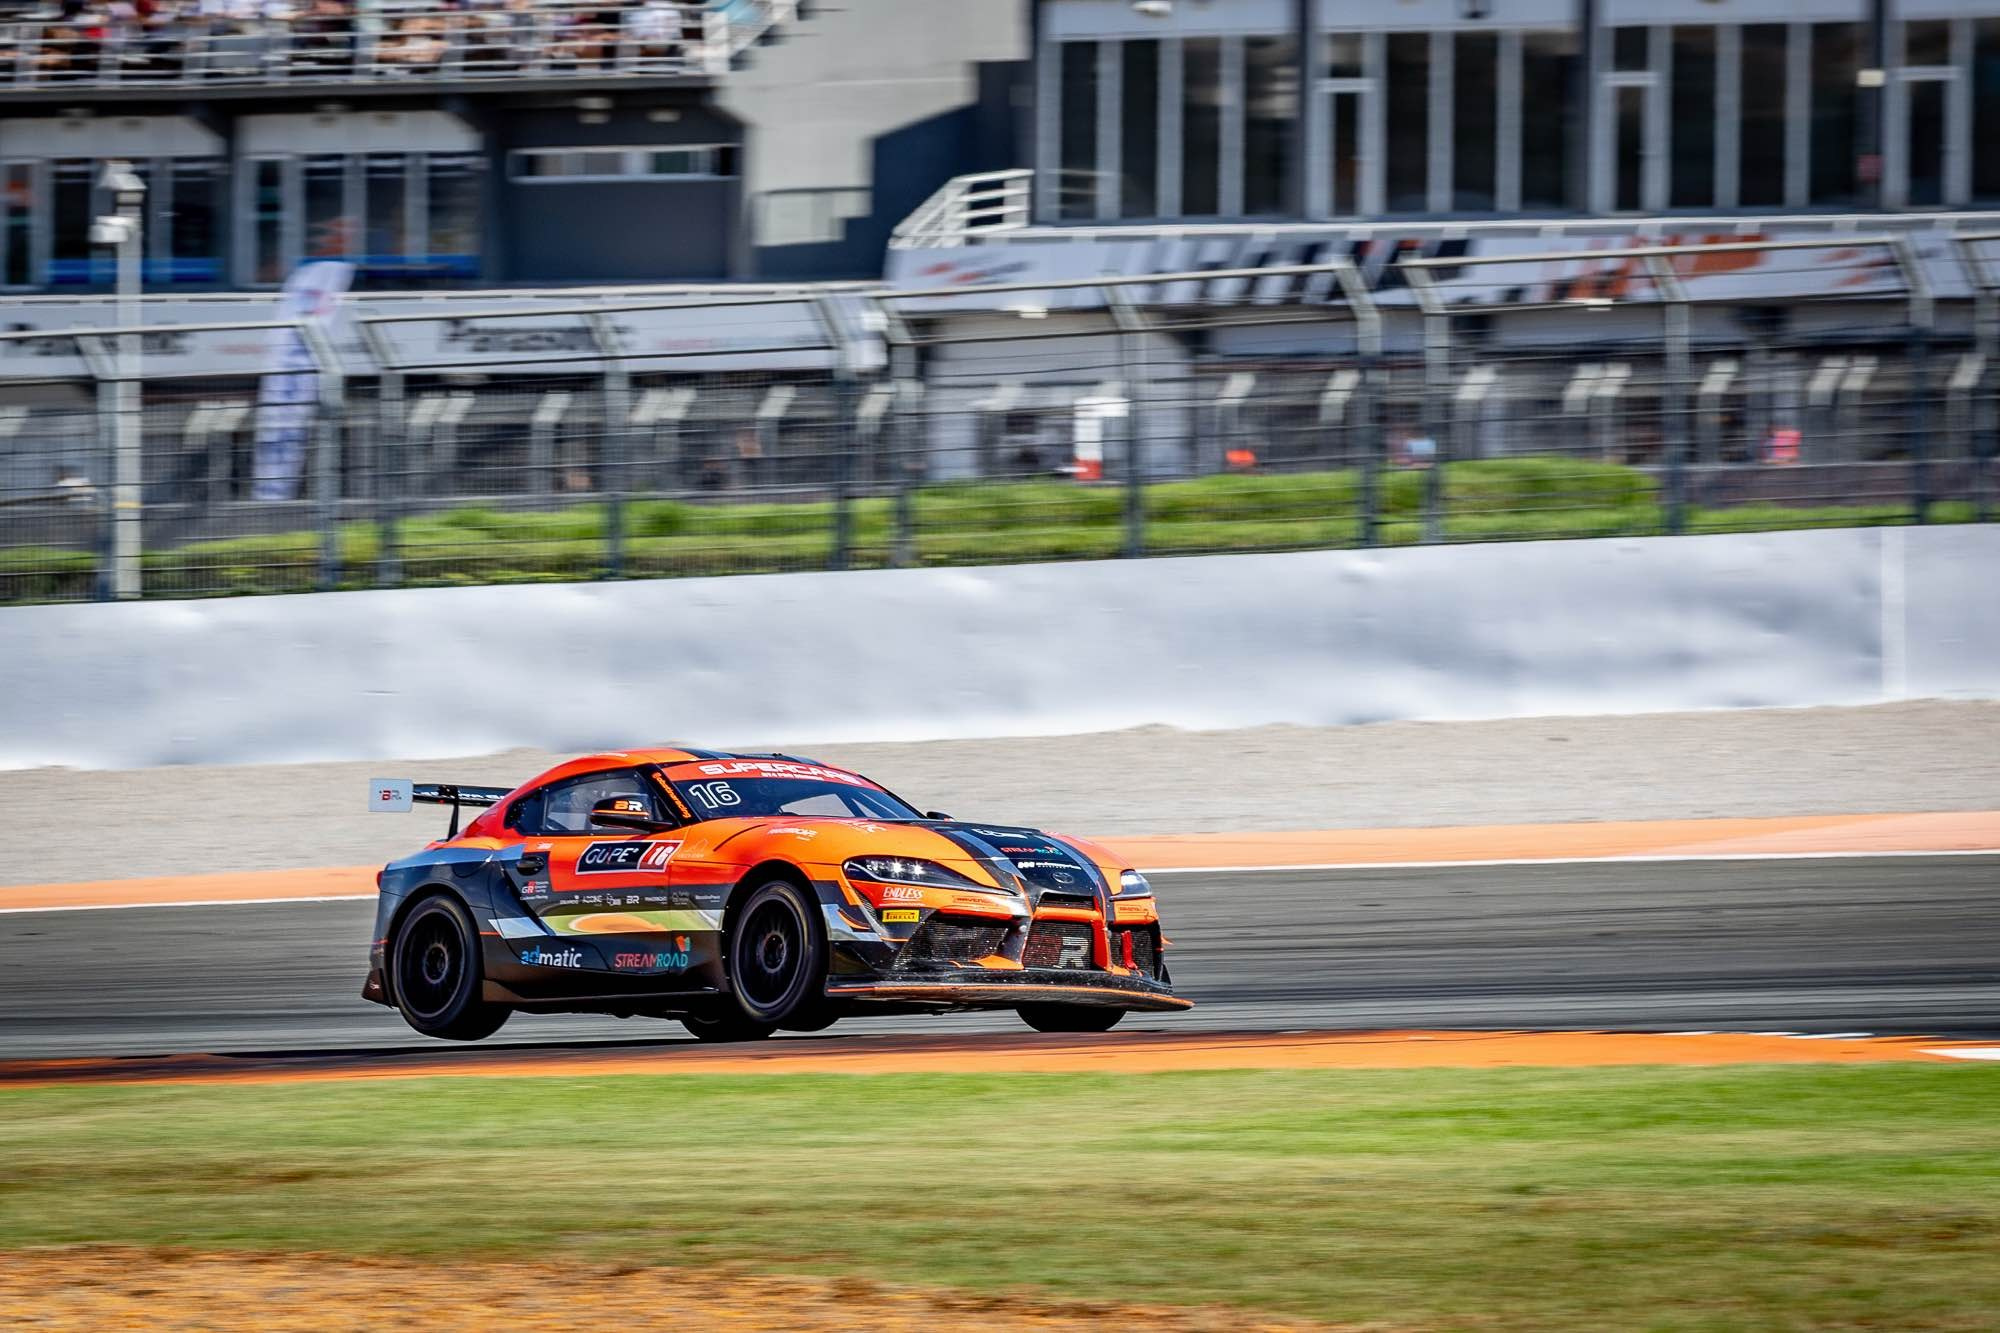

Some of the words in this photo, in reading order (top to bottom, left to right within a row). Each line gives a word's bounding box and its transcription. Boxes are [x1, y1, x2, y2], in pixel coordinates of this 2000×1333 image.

[698, 762, 863, 785] SUPERCARS
[614, 800, 643, 811] BR
[688, 781, 741, 809] 16
[647, 845, 674, 866] 16
[883, 886, 924, 899] ENDLESS
[521, 945, 583, 968] admatic
[614, 953, 689, 968] STREAMROAD
